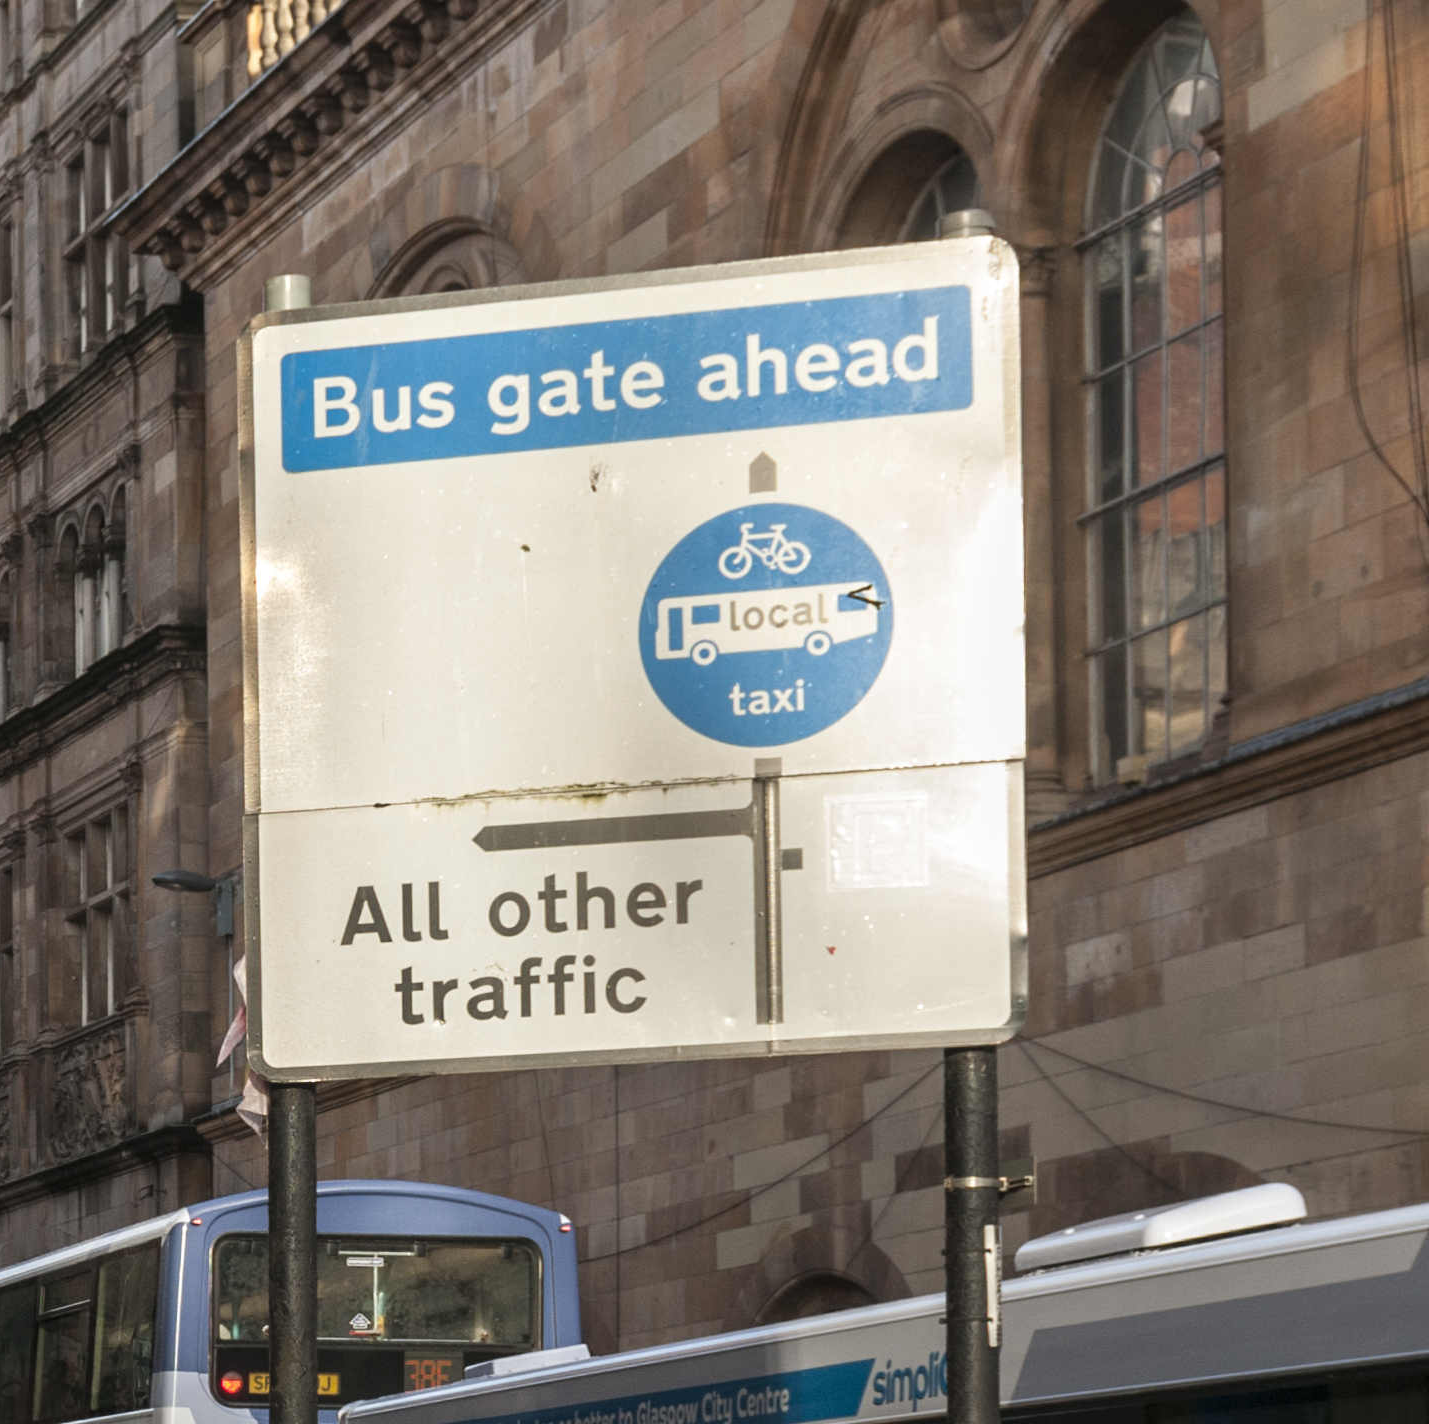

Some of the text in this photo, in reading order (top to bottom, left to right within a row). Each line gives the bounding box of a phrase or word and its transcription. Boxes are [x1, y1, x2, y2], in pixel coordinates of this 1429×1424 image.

[311, 315, 941, 440] Bus gate ahead
[729, 593, 829, 632] local
[728, 679, 807, 718] taxi
[340, 871, 704, 947] All other
[393, 955, 649, 1026] traffic
[736, 1386, 791, 1418] Centre
